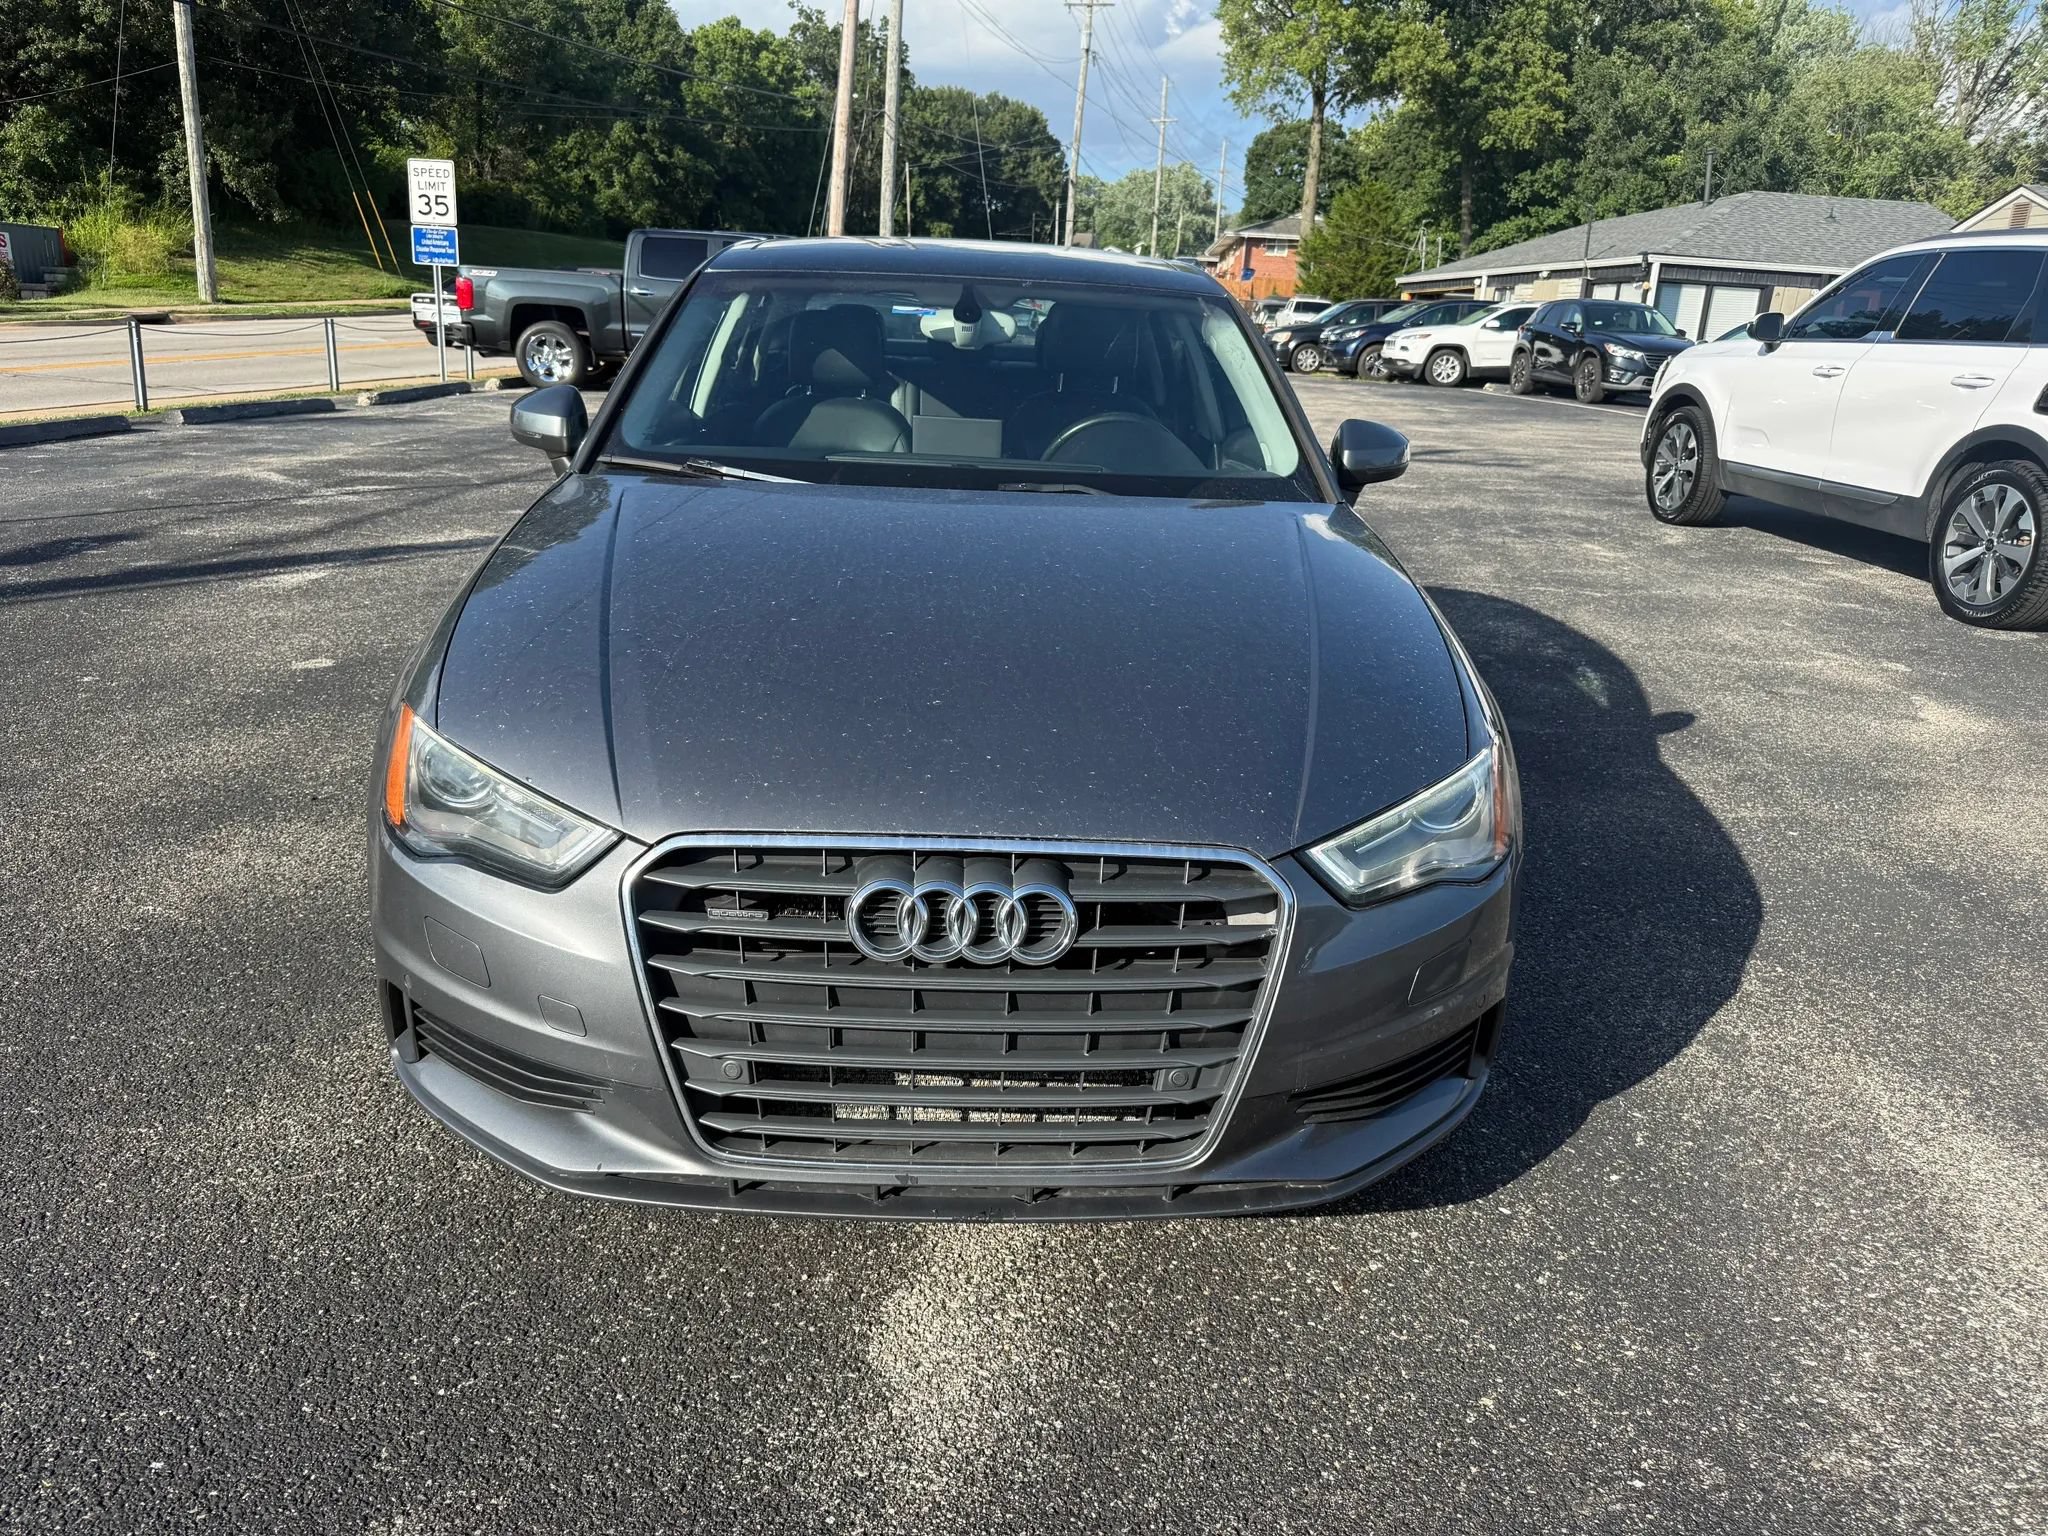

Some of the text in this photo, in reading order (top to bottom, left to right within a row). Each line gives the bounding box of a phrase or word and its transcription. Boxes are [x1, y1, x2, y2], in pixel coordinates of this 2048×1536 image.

[413, 167, 450, 179] SPEED
[418, 180, 447, 191] LIMIT
[418, 194, 449, 216] 35
[712, 910, 763, 918] quattro
